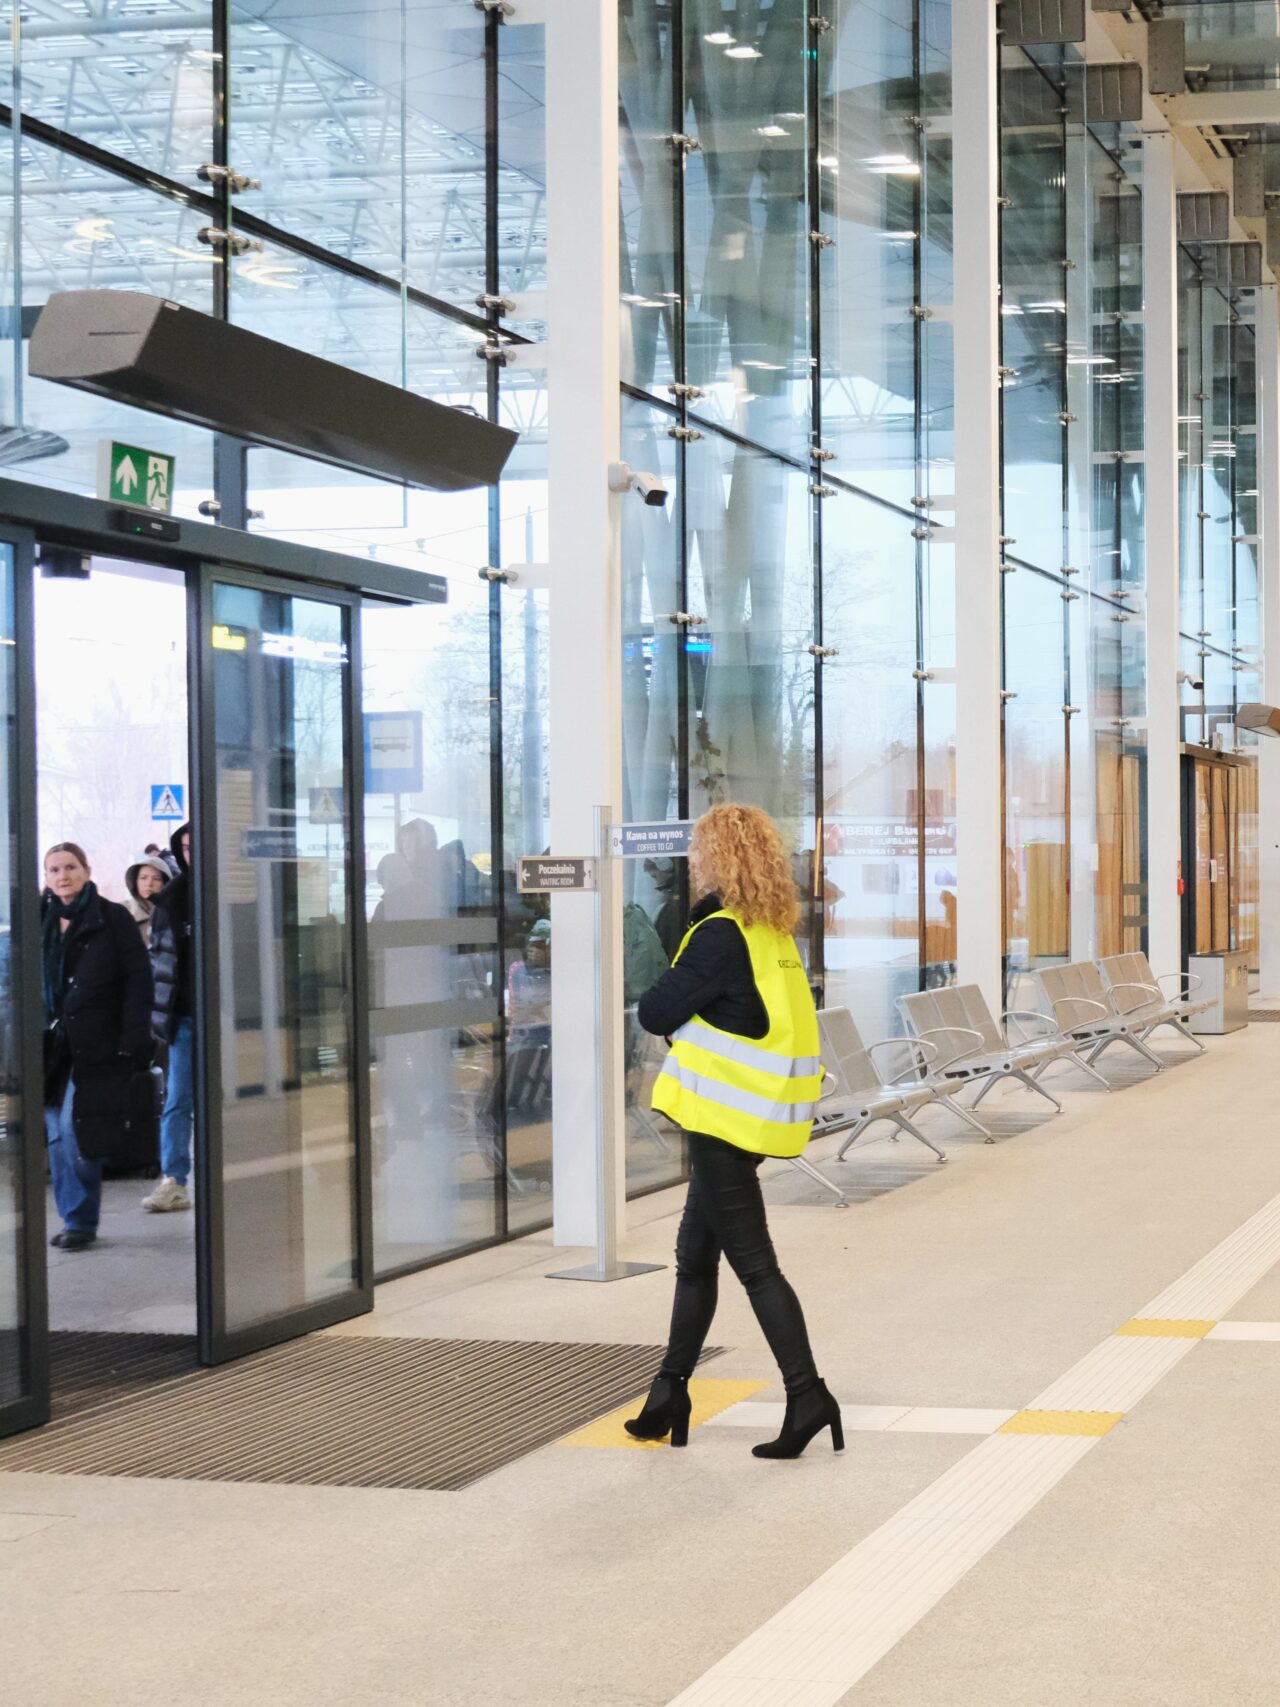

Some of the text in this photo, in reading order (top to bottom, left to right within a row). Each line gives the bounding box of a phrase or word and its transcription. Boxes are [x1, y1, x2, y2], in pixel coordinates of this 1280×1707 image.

[626, 830, 684, 841] Kawa na wynos
[637, 842, 674, 852] COFFEE TO GO
[538, 864, 576, 875] Poczekalnia
